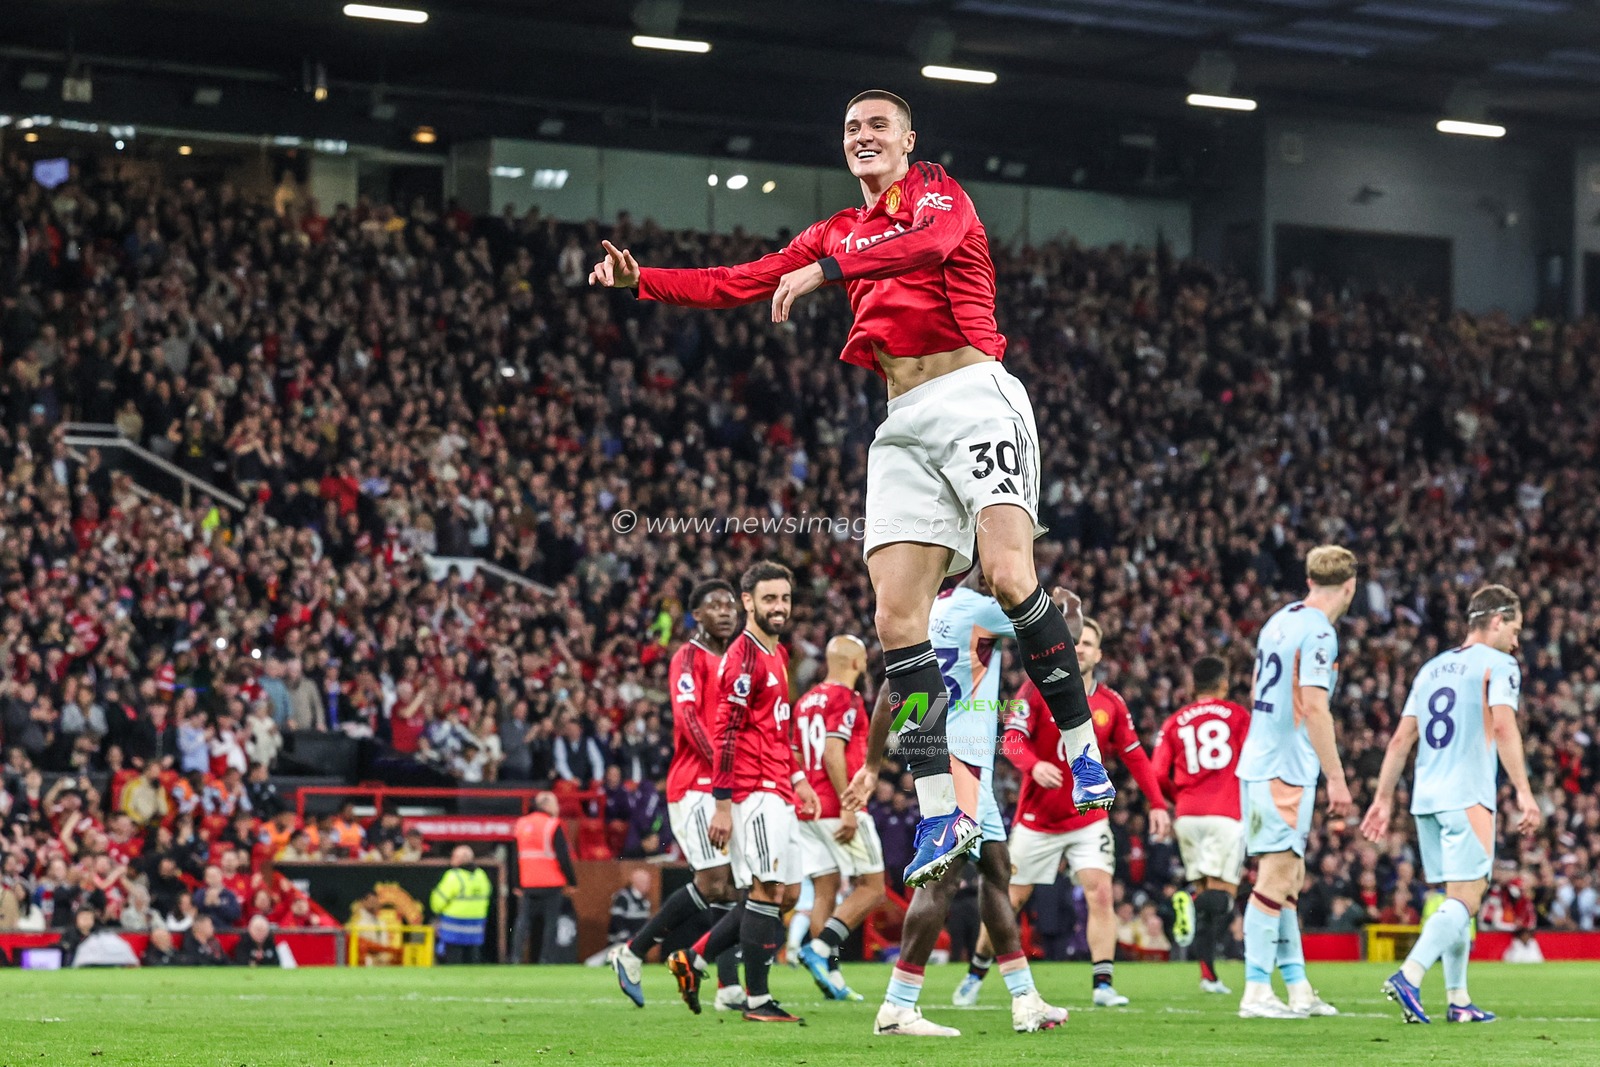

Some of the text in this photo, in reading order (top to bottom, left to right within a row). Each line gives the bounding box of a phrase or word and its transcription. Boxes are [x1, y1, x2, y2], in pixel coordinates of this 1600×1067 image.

[969, 440, 1020, 479] 30
[797, 713, 826, 771] 19
[1425, 686, 1456, 750] 8
[1177, 719, 1233, 775] 18
